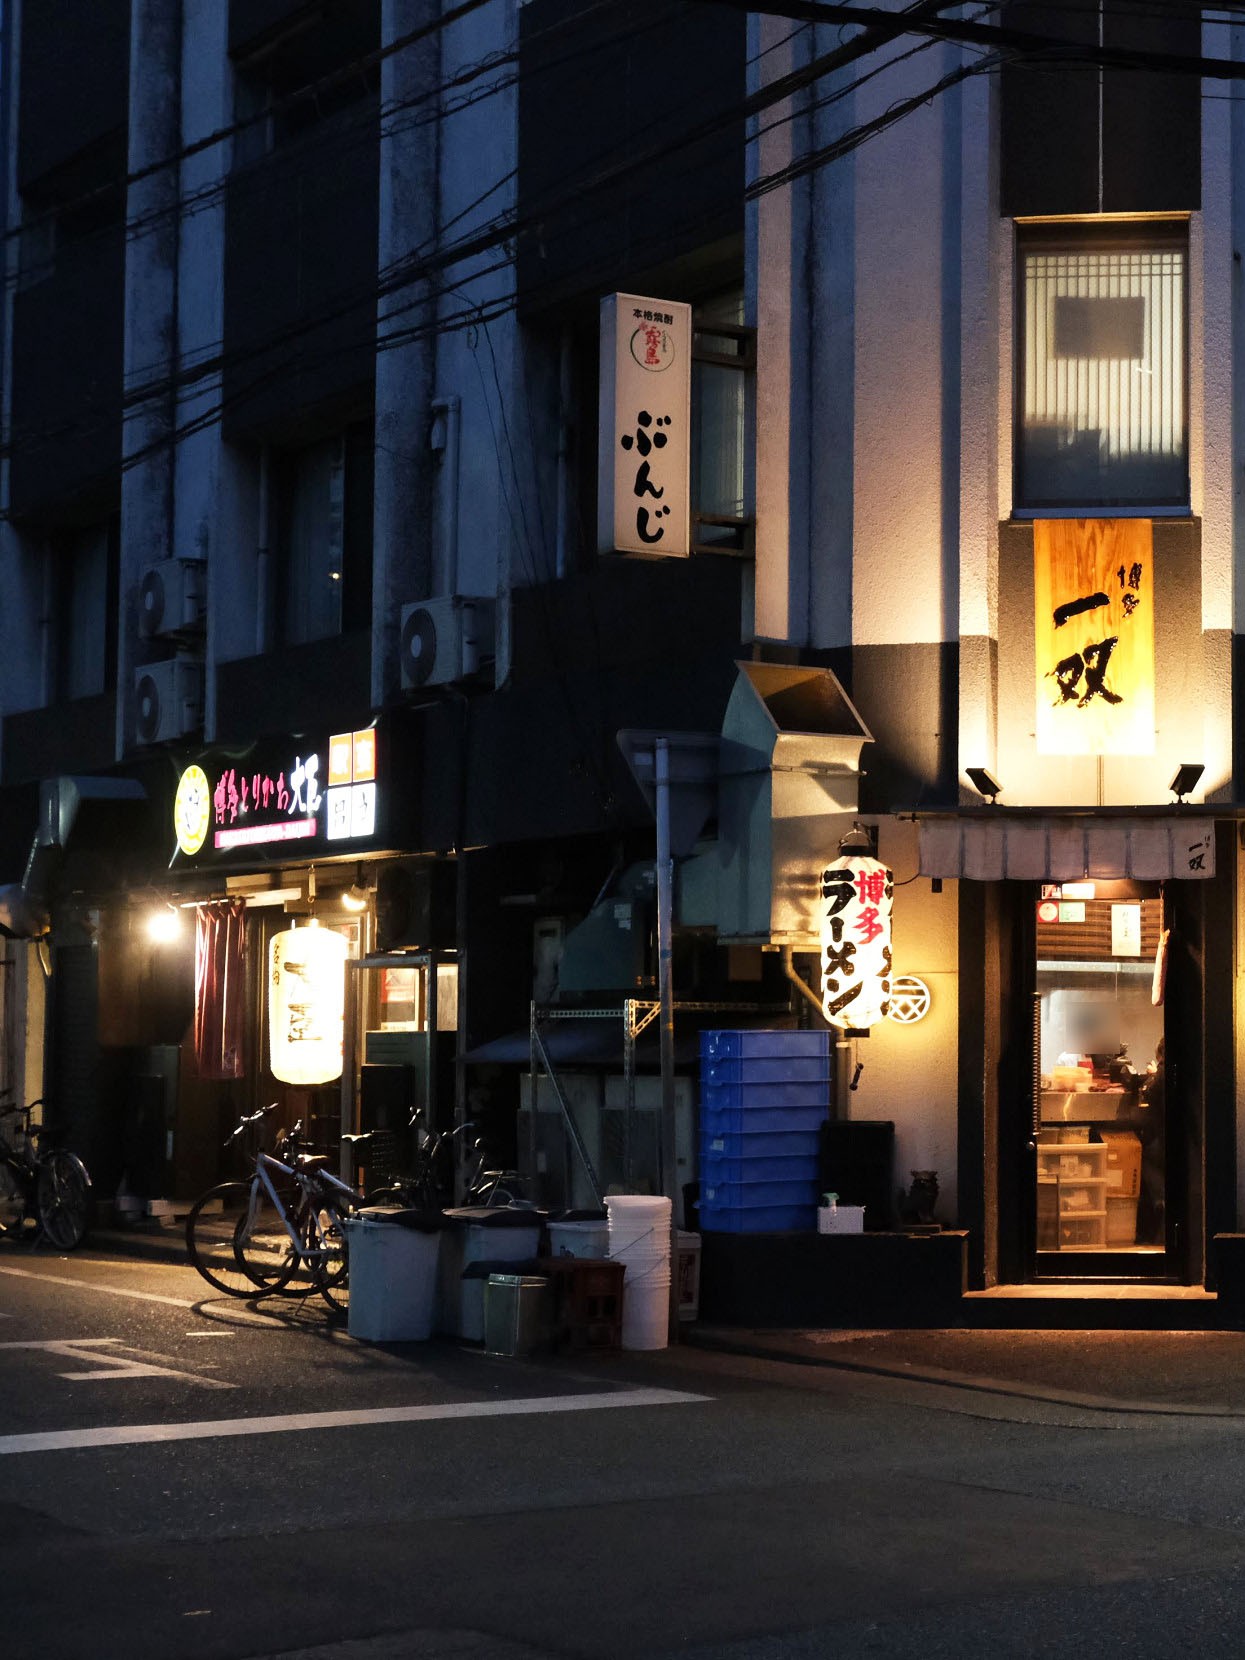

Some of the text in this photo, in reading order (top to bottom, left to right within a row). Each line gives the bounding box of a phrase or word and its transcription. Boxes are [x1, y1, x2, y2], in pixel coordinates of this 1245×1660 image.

[633, 308, 673, 325] 本格焼酎
[621, 410, 671, 543] ぶんじ
[1117, 563, 1142, 618] 博多
[823, 868, 863, 1016] ラーメン
[853, 868, 885, 944] 博多
